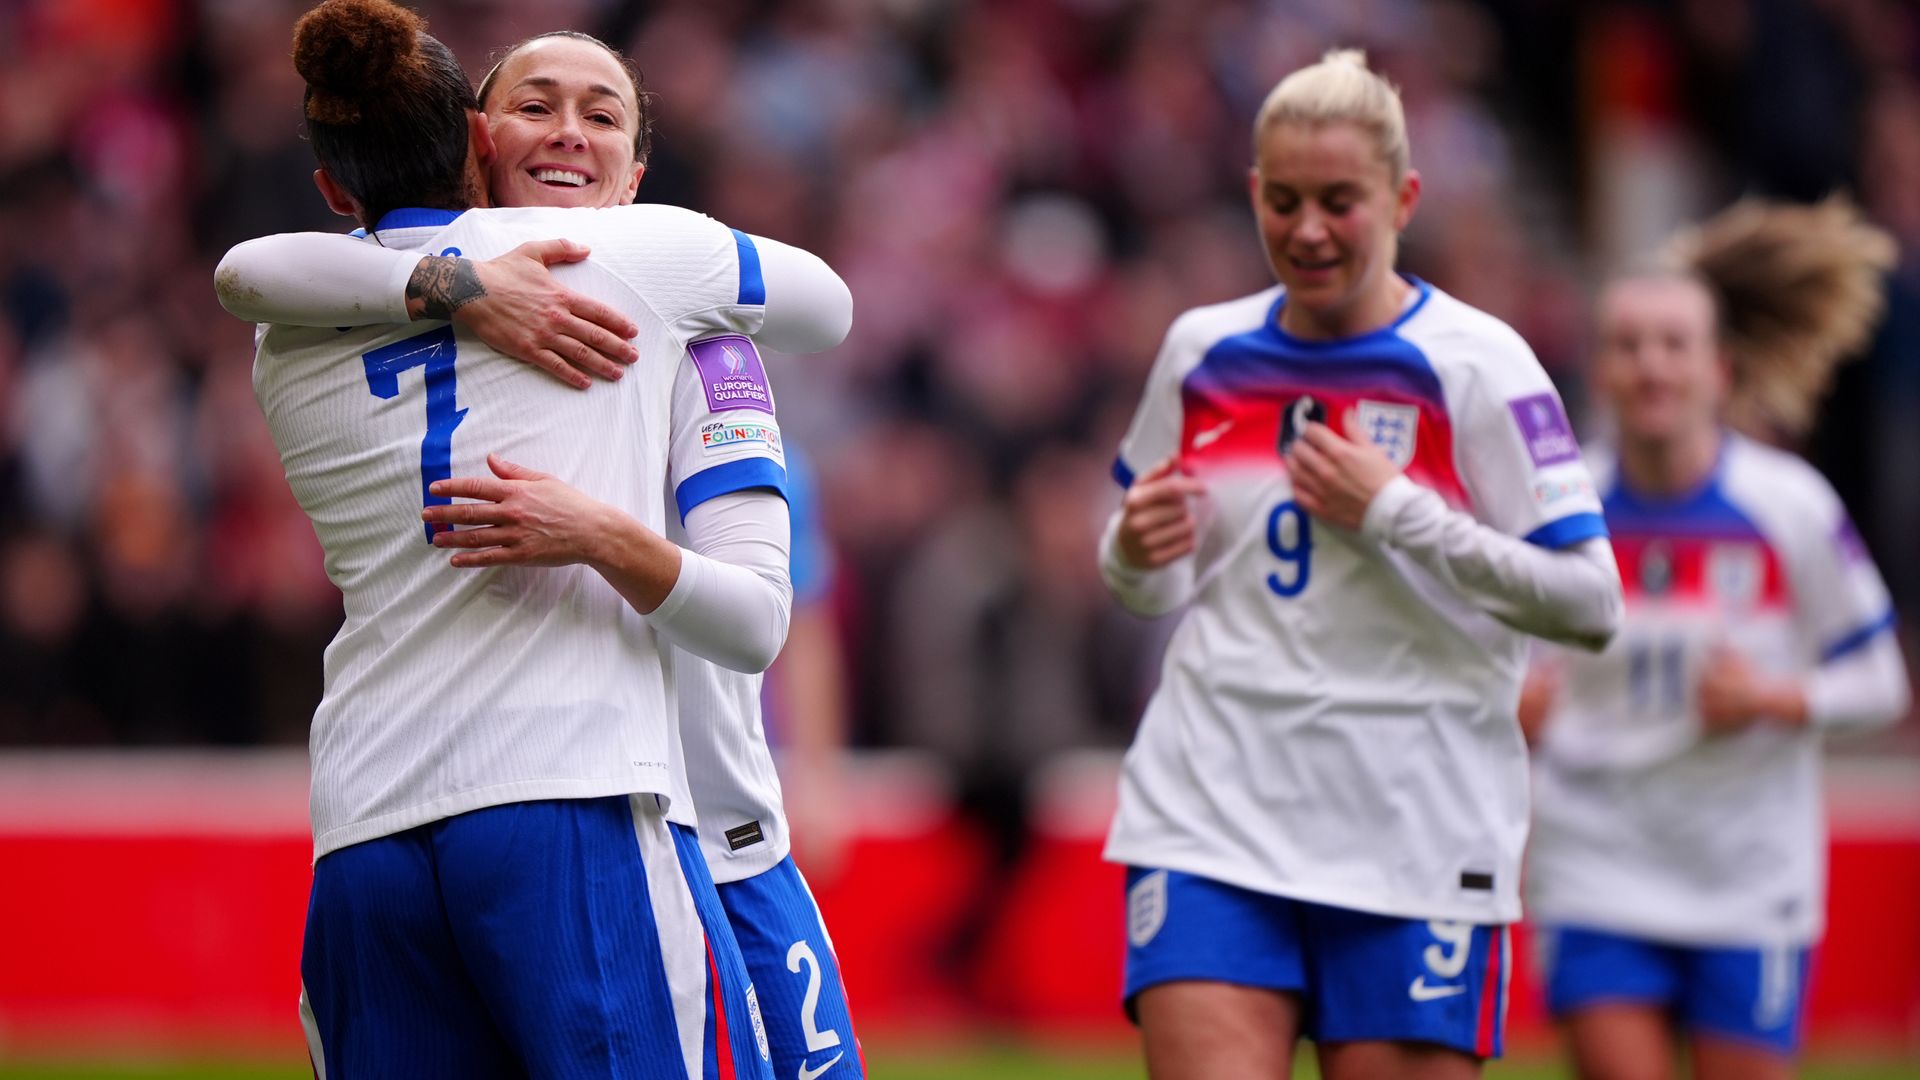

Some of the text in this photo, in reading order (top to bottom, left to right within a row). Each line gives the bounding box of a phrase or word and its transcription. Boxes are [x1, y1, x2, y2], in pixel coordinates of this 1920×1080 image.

[713, 382, 765, 393] EUROPEAN
[714, 391, 768, 402] QUALIFIERS
[362, 324, 469, 545] 7
[701, 423, 725, 433] UEFA
[703, 427, 780, 445] FOUNDATION
[1267, 500, 1312, 598] 9
[1423, 920, 1475, 978] 9
[786, 940, 841, 1053] 2
